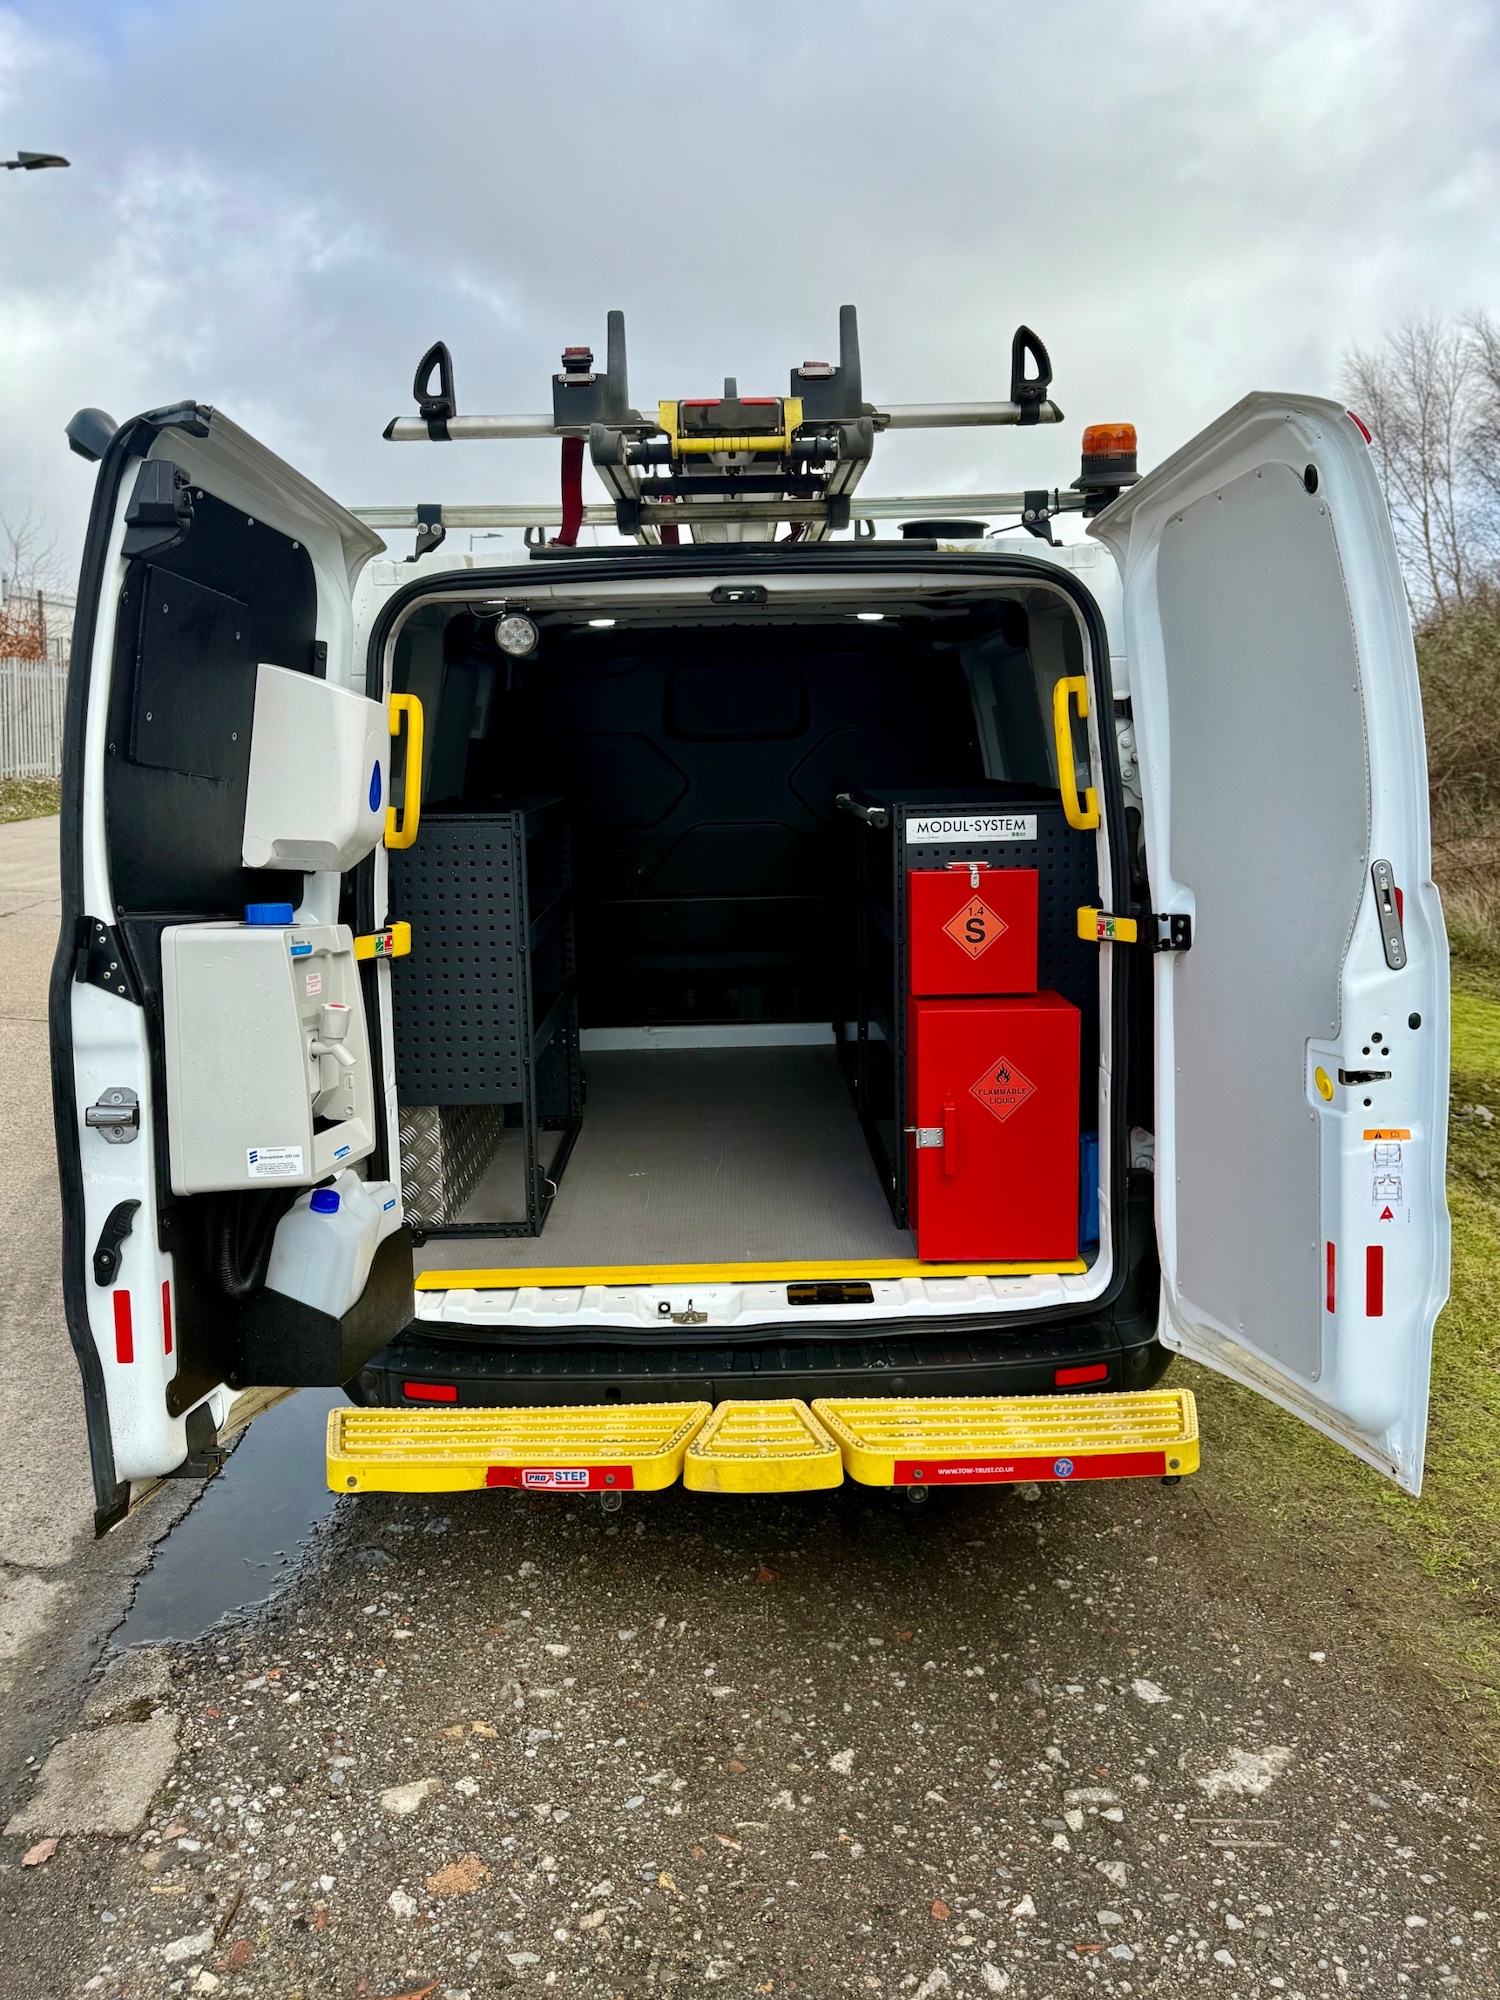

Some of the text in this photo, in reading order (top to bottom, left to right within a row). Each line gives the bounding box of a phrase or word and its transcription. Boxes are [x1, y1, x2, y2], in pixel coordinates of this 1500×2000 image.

[917, 819, 1026, 833] MODUL-SYSTEM
[968, 907, 984, 916] 1.4
[965, 918, 986, 944] S
[555, 1471, 586, 1481] STEP
